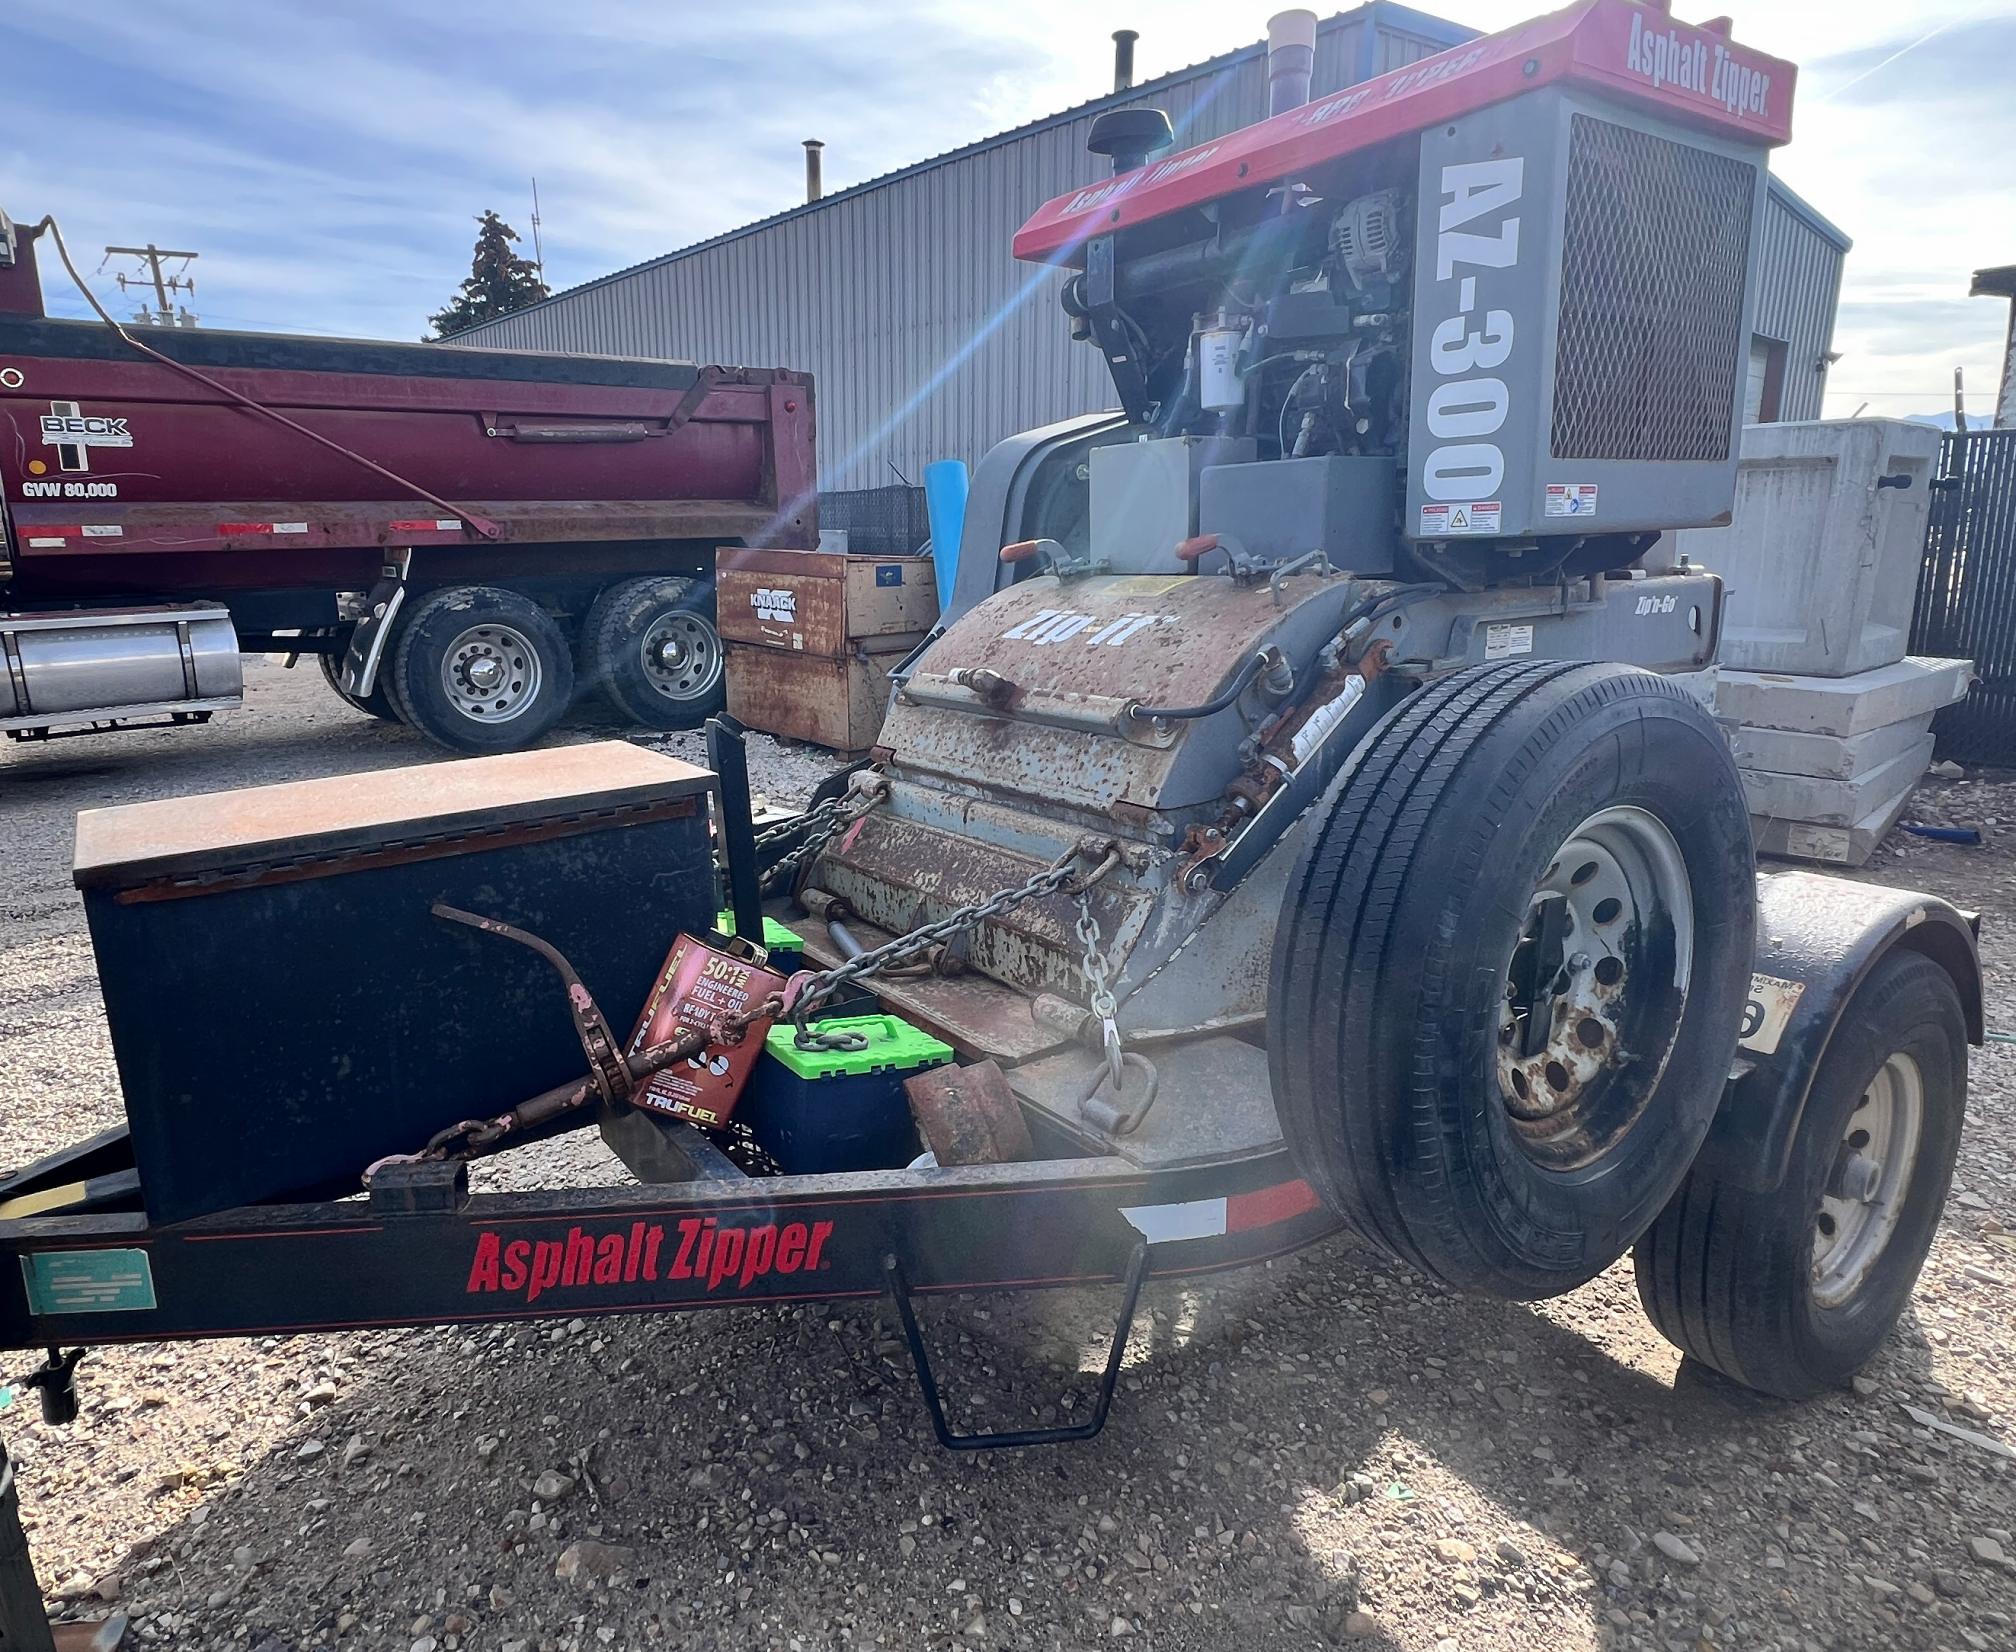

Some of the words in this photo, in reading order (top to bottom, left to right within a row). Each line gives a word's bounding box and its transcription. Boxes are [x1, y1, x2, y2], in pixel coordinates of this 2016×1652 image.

[1627, 12, 1708, 95] Asphalt
[1711, 44, 1771, 117] Zipper
[1423, 157, 1524, 501] AZ-300
[40, 415, 132, 436] BECK
[22, 482, 61, 497] GVW
[64, 483, 117, 499] 80,000
[750, 593, 796, 611] KNAACK
[702, 956, 741, 985] 50:1
[735, 969, 750, 988] MIX
[691, 985, 716, 1003] FUEL
[697, 975, 749, 1001] ENGINEERED
[683, 1003, 711, 1020] READY
[646, 1092, 718, 1124] TRUFUEL
[466, 1222, 664, 1303] Asphalt
[667, 1217, 833, 1292] Zipper
